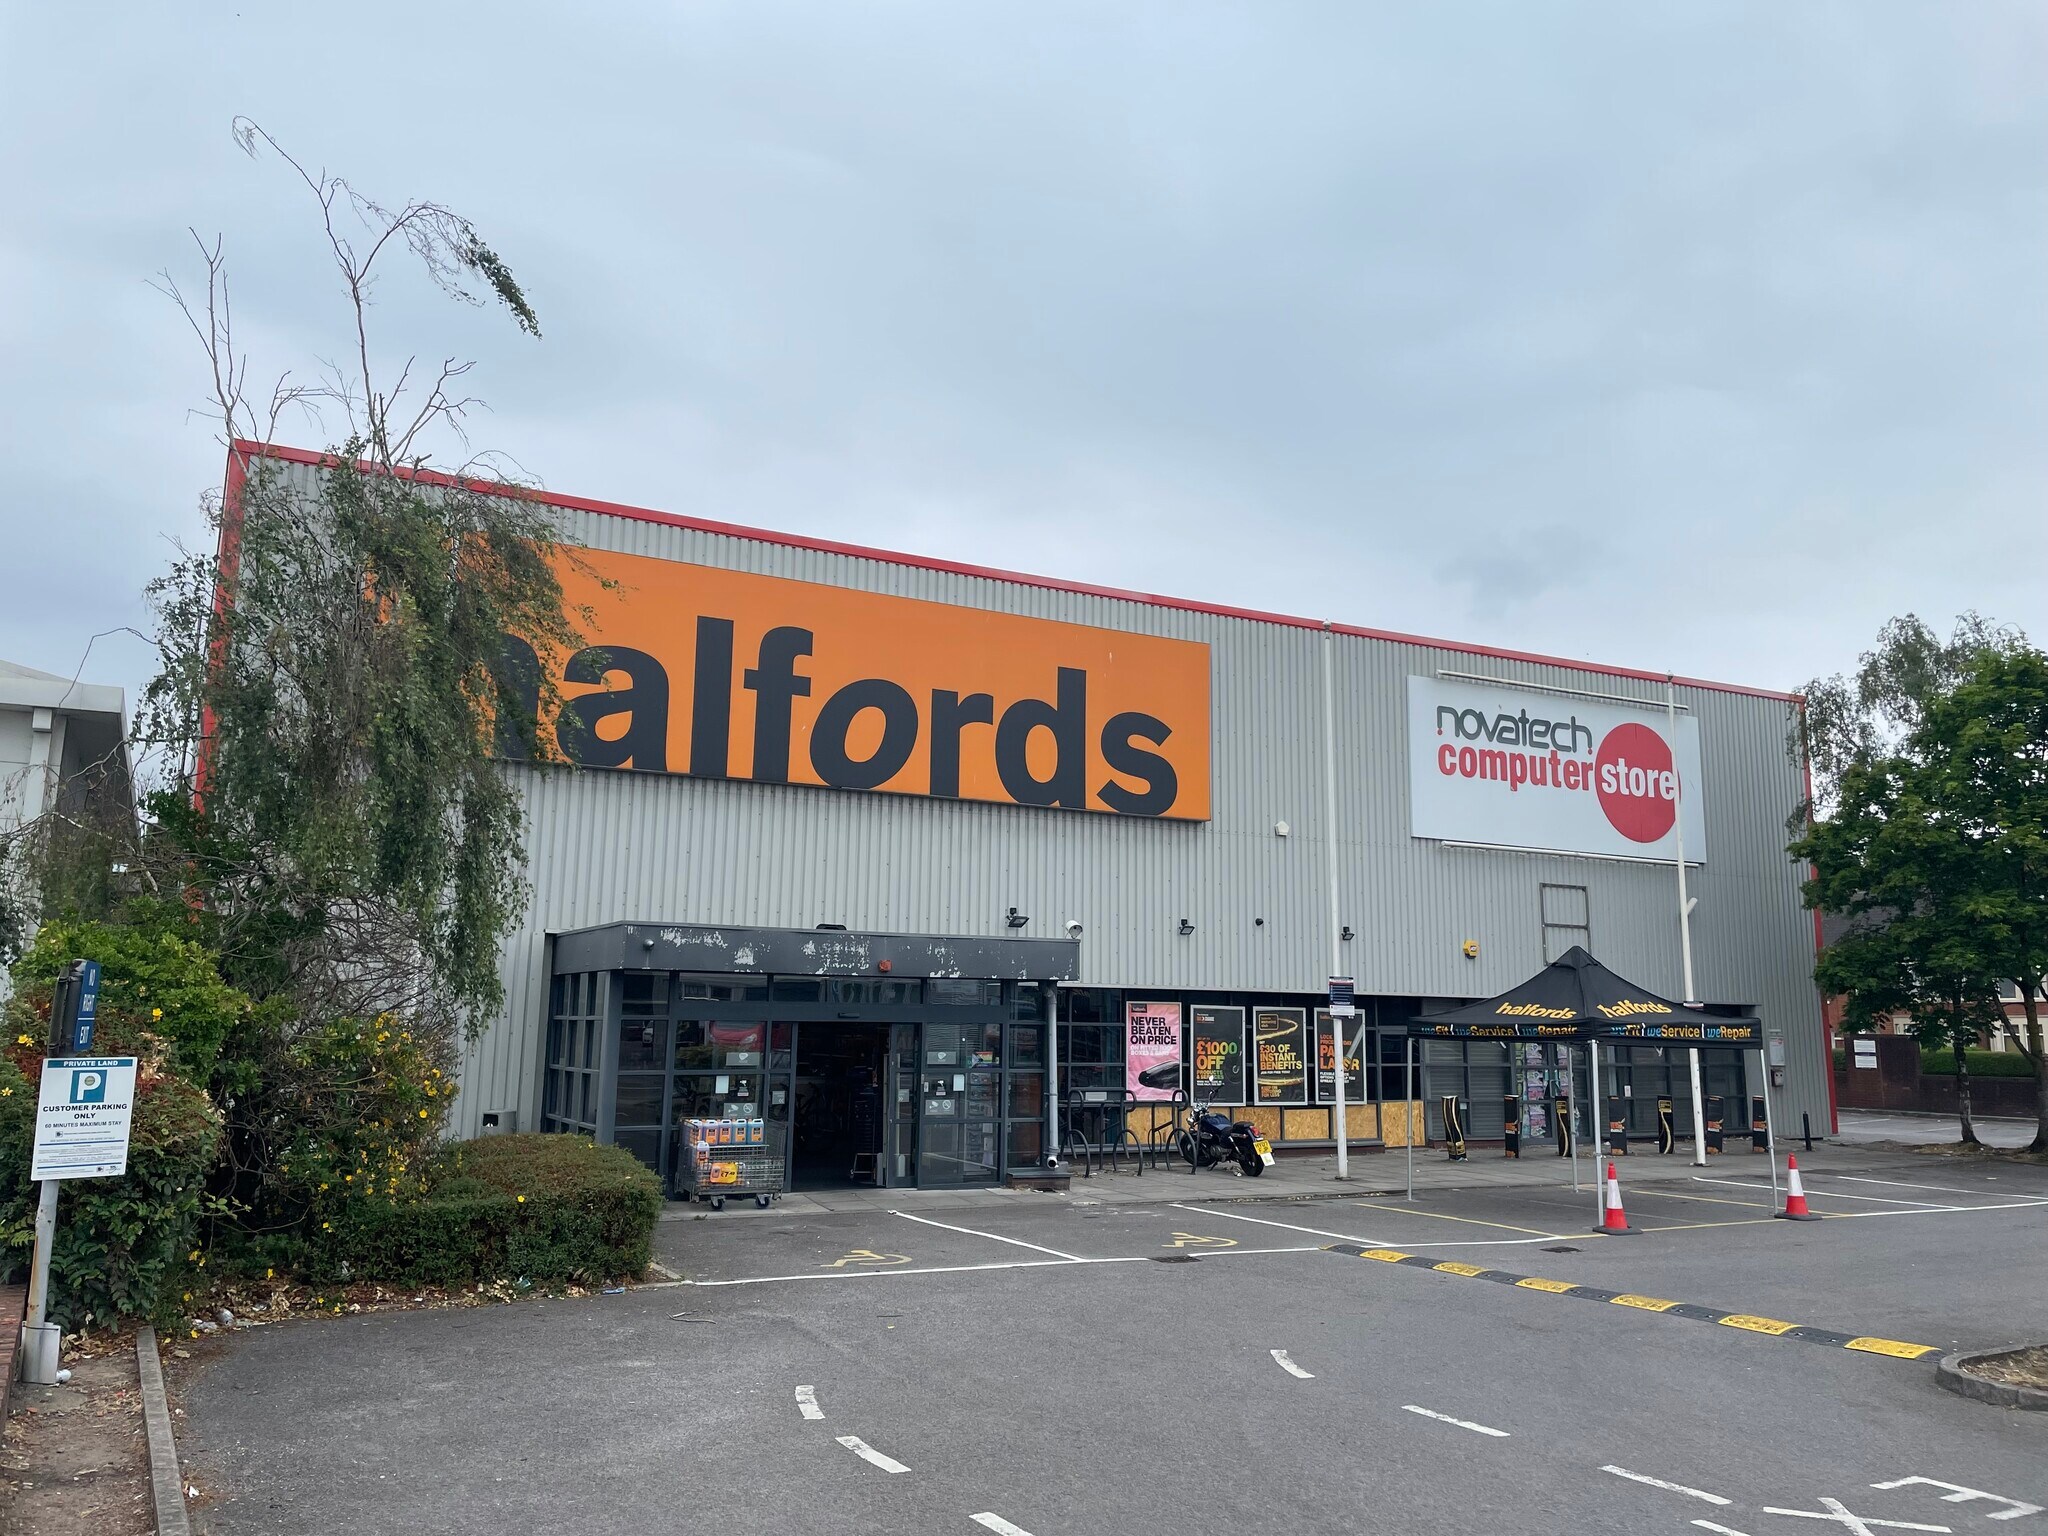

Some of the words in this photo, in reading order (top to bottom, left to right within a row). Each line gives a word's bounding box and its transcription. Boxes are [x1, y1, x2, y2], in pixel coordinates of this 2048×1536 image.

[1436, 705, 1593, 755] novatech
[1437, 743, 1593, 791] computer
[1601, 758, 1676, 800] store
[1495, 1002, 1578, 1020] halfords
[1597, 999, 1673, 1018] halfords
[1131, 1017, 1166, 1026] NEVER
[1131, 1026, 1171, 1035] BEATEN
[1647, 1024, 1700, 1038] weService
[1707, 1025, 1751, 1040] weRepair
[1130, 1036, 1145, 1044] ON
[1148, 1036, 1176, 1044] PRICE
[1197, 1041, 1238, 1055] £1000
[1260, 1044, 1276, 1053] £30
[1278, 1044, 1291, 1053] OF
[1320, 1044, 1335, 1057] PA
[1197, 1055, 1225, 1070] OFF
[1260, 1053, 1296, 1061] INSTANT
[1260, 1061, 1303, 1070] BENEFITS
[42, 1104, 89, 1112] CUSTOMER
[91, 1103, 128, 1111] PARKING
